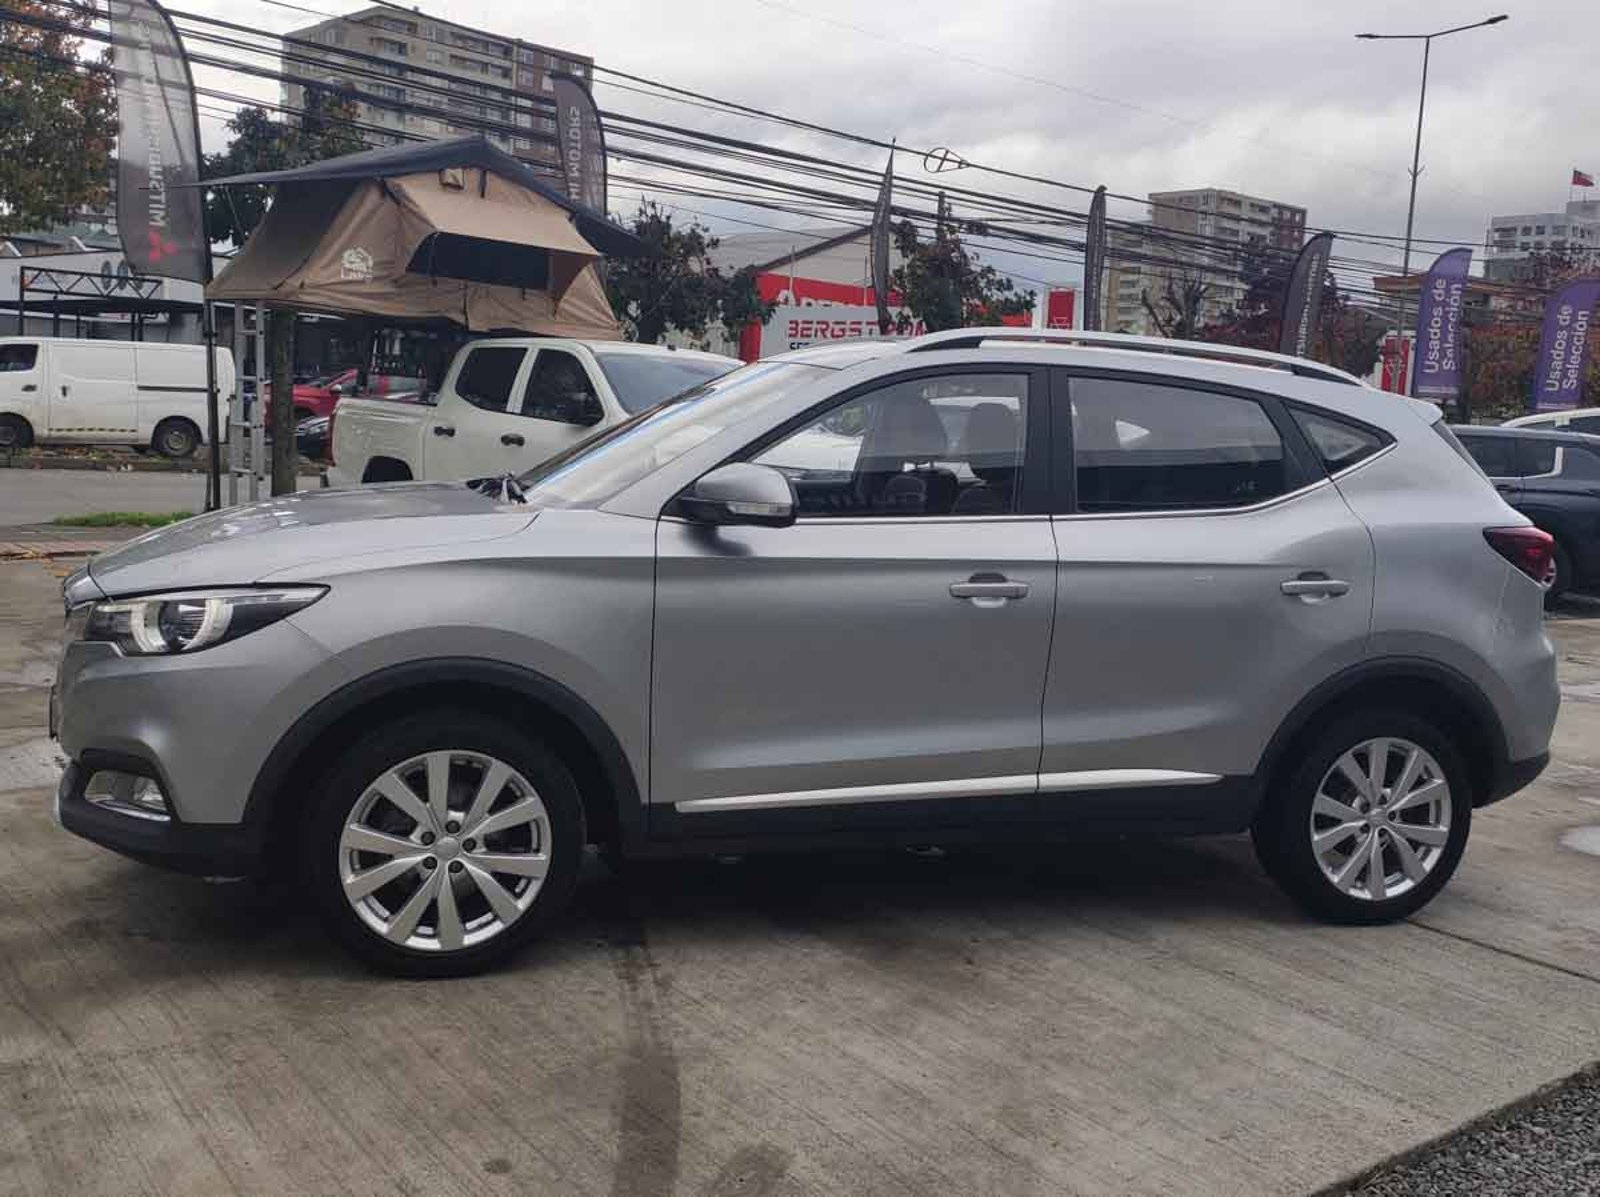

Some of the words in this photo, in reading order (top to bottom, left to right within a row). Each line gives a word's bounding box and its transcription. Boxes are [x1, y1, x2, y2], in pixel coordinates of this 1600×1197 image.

[1431, 278, 1447, 301] de
[1422, 306, 1443, 374] Usados
[1544, 329, 1568, 392] Usados
[1557, 304, 1574, 327] de
